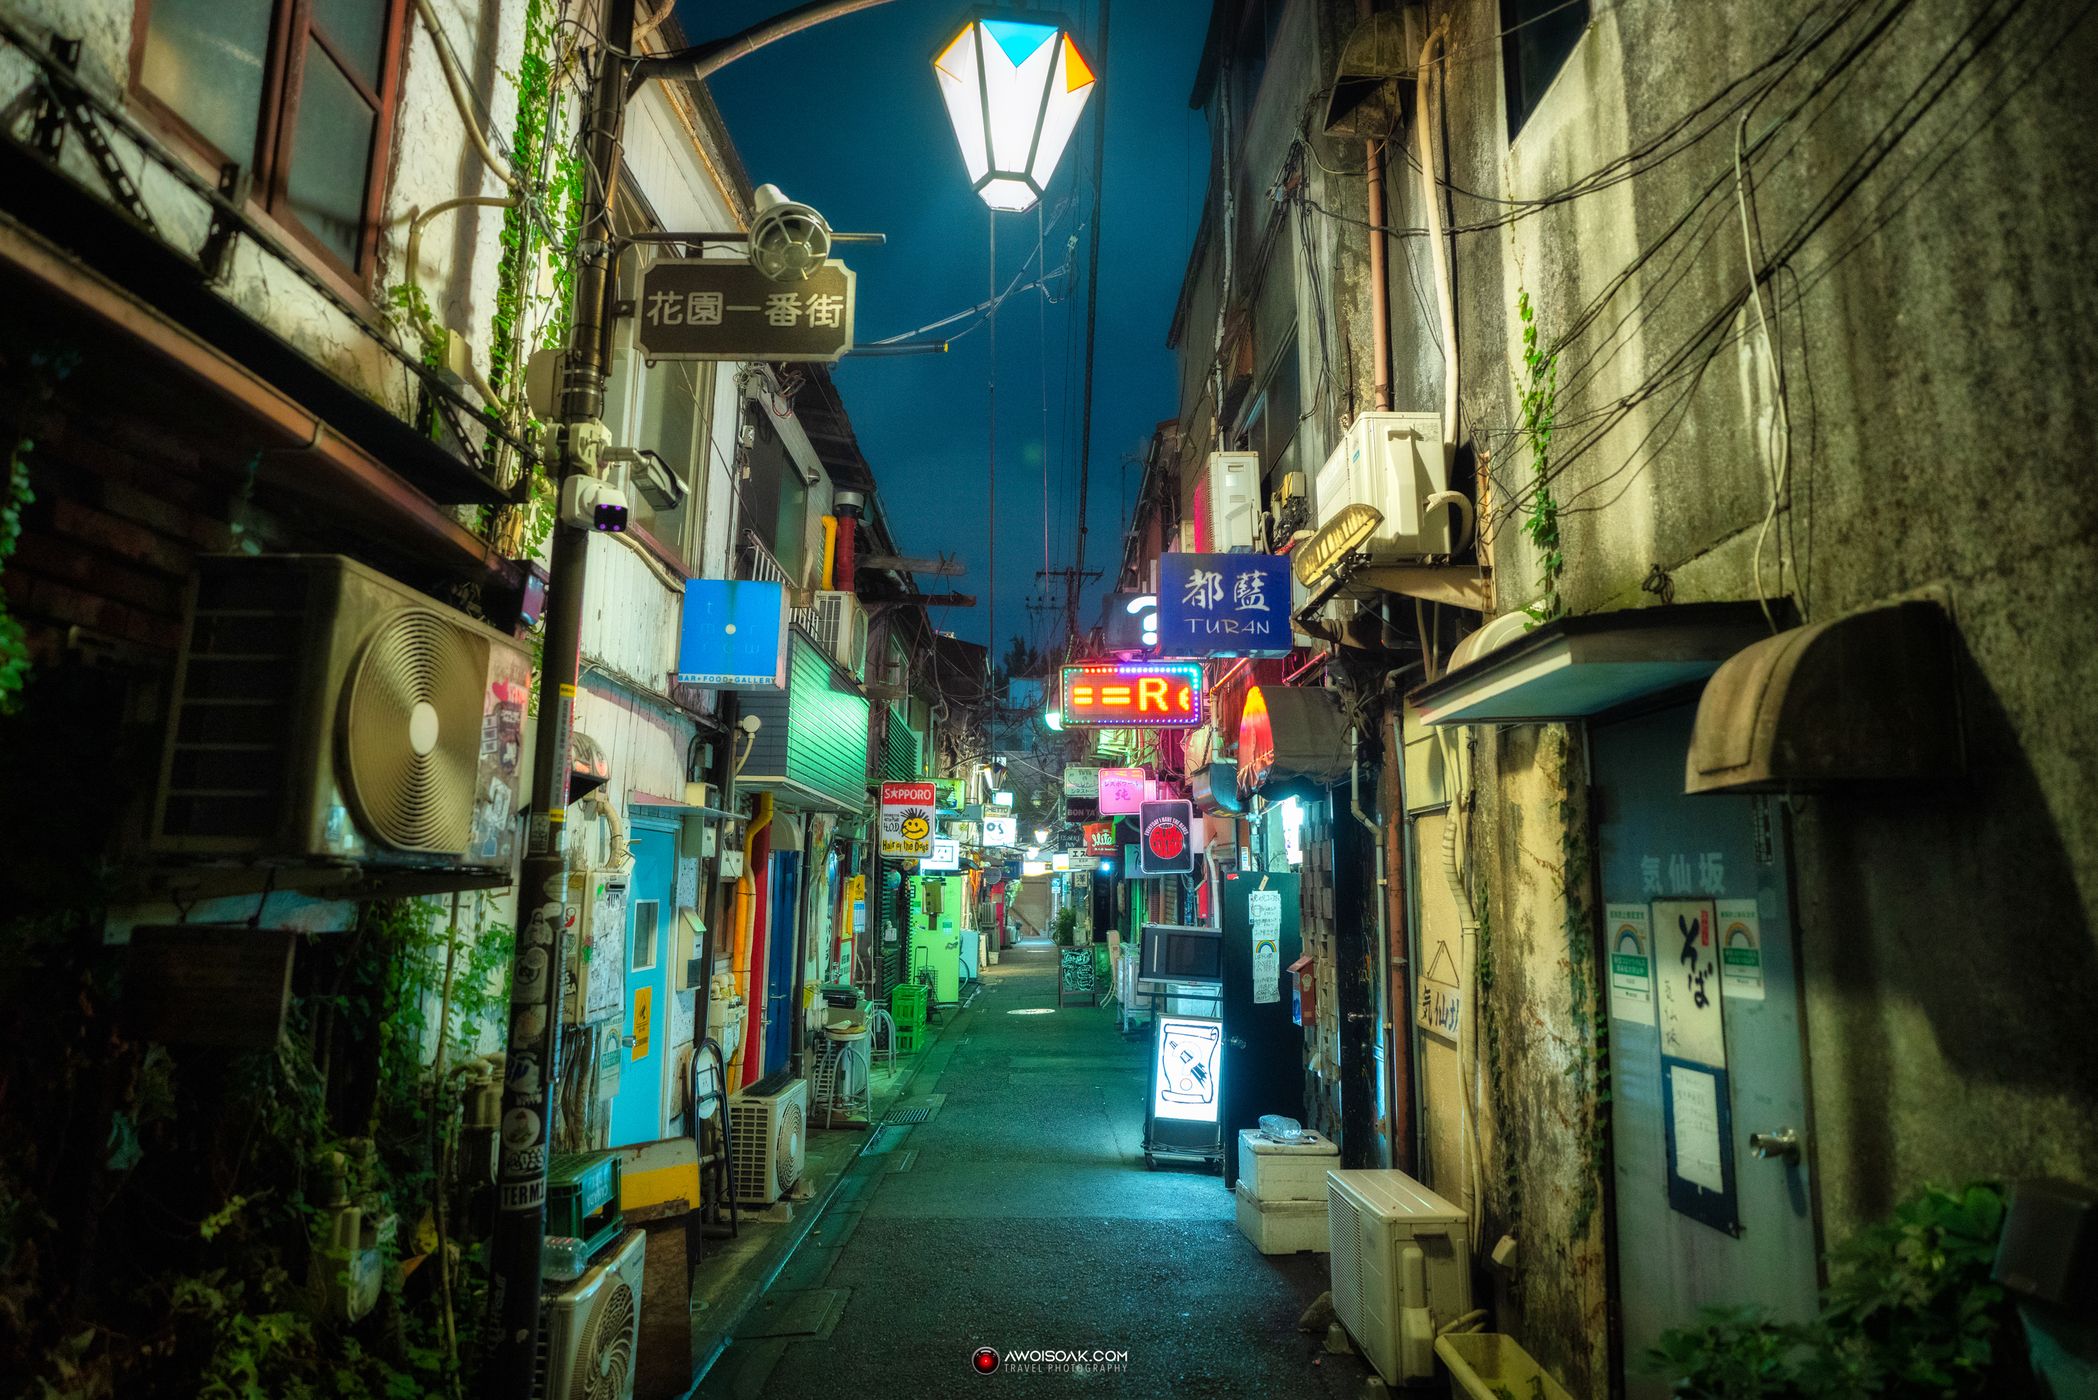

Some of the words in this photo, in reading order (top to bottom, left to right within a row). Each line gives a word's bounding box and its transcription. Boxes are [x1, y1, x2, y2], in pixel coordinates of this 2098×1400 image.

[647, 290, 844, 329] 花園一番街
[1184, 618, 1270, 635] TURAN
[678, 675, 696, 683] BAR
[703, 675, 728, 684] FOOD
